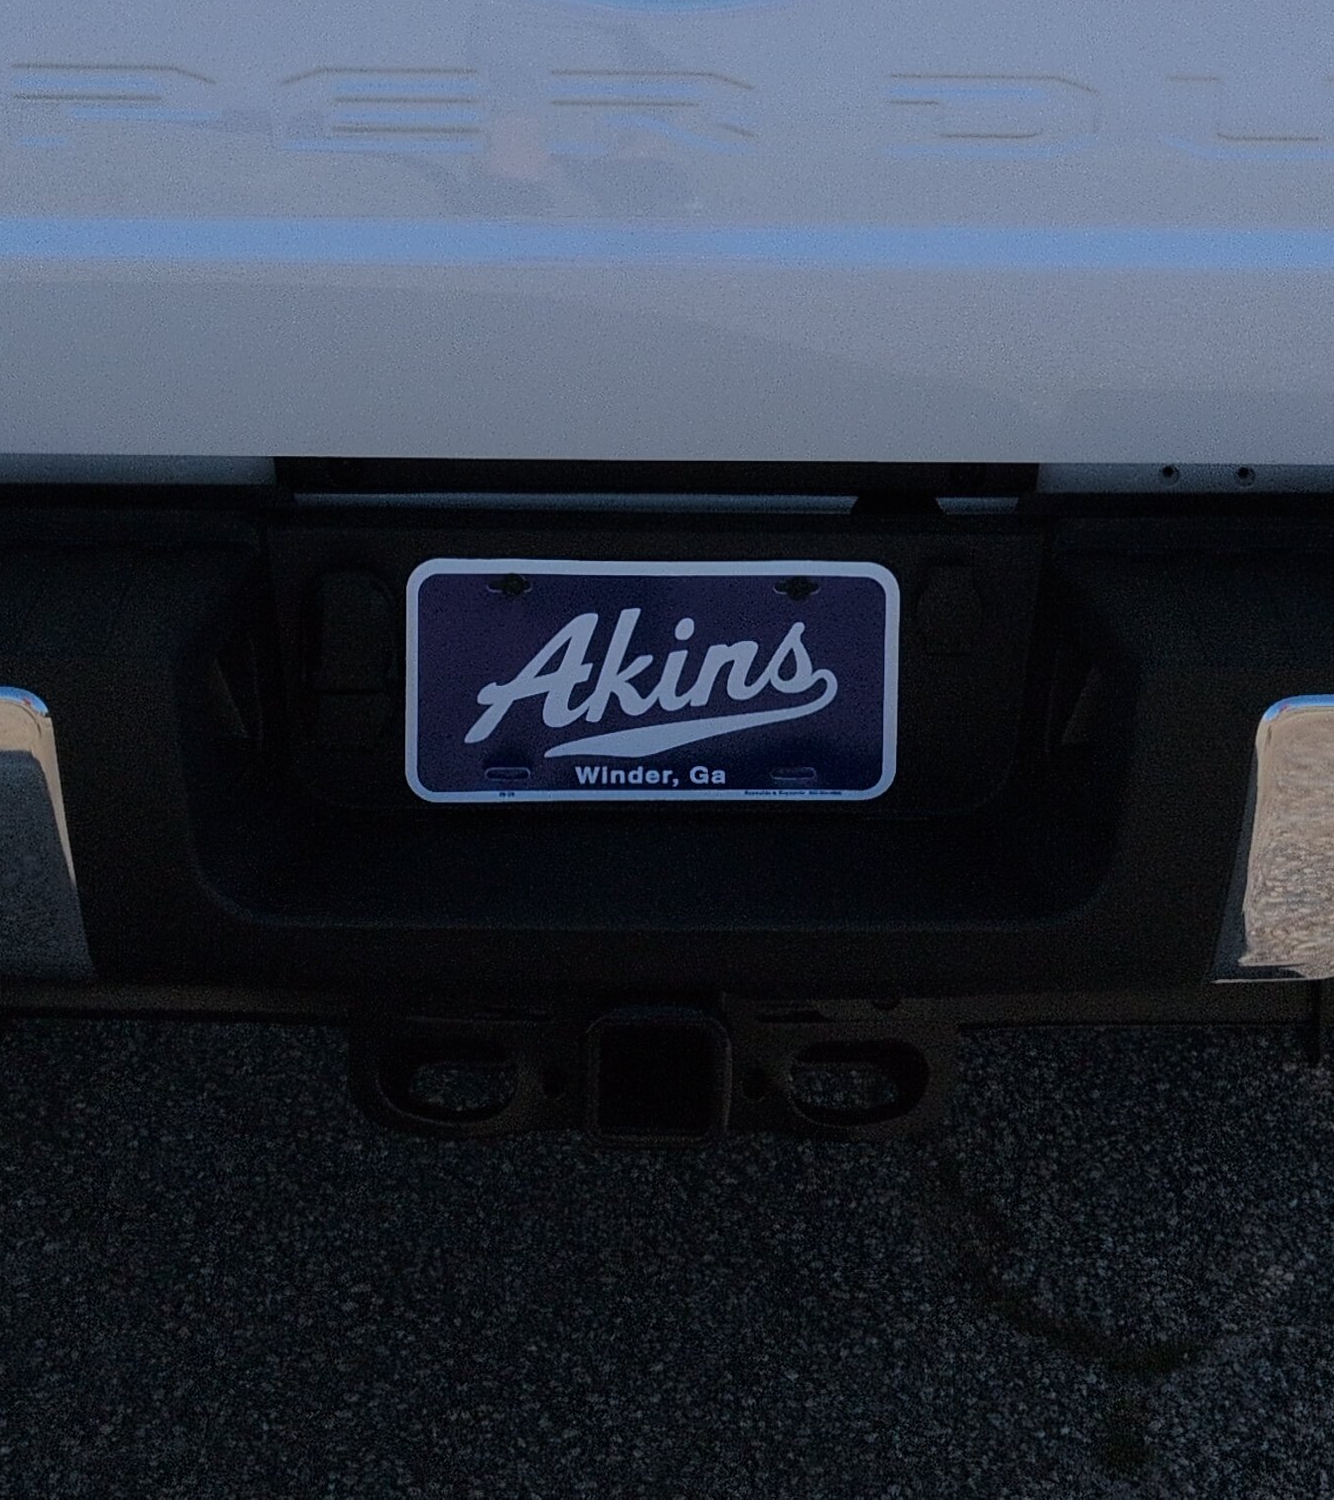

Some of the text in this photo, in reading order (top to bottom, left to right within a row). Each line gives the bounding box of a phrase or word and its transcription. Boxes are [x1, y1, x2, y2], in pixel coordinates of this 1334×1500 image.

[464, 607, 838, 758] Akins
[575, 765, 726, 786] Winder, Ga
